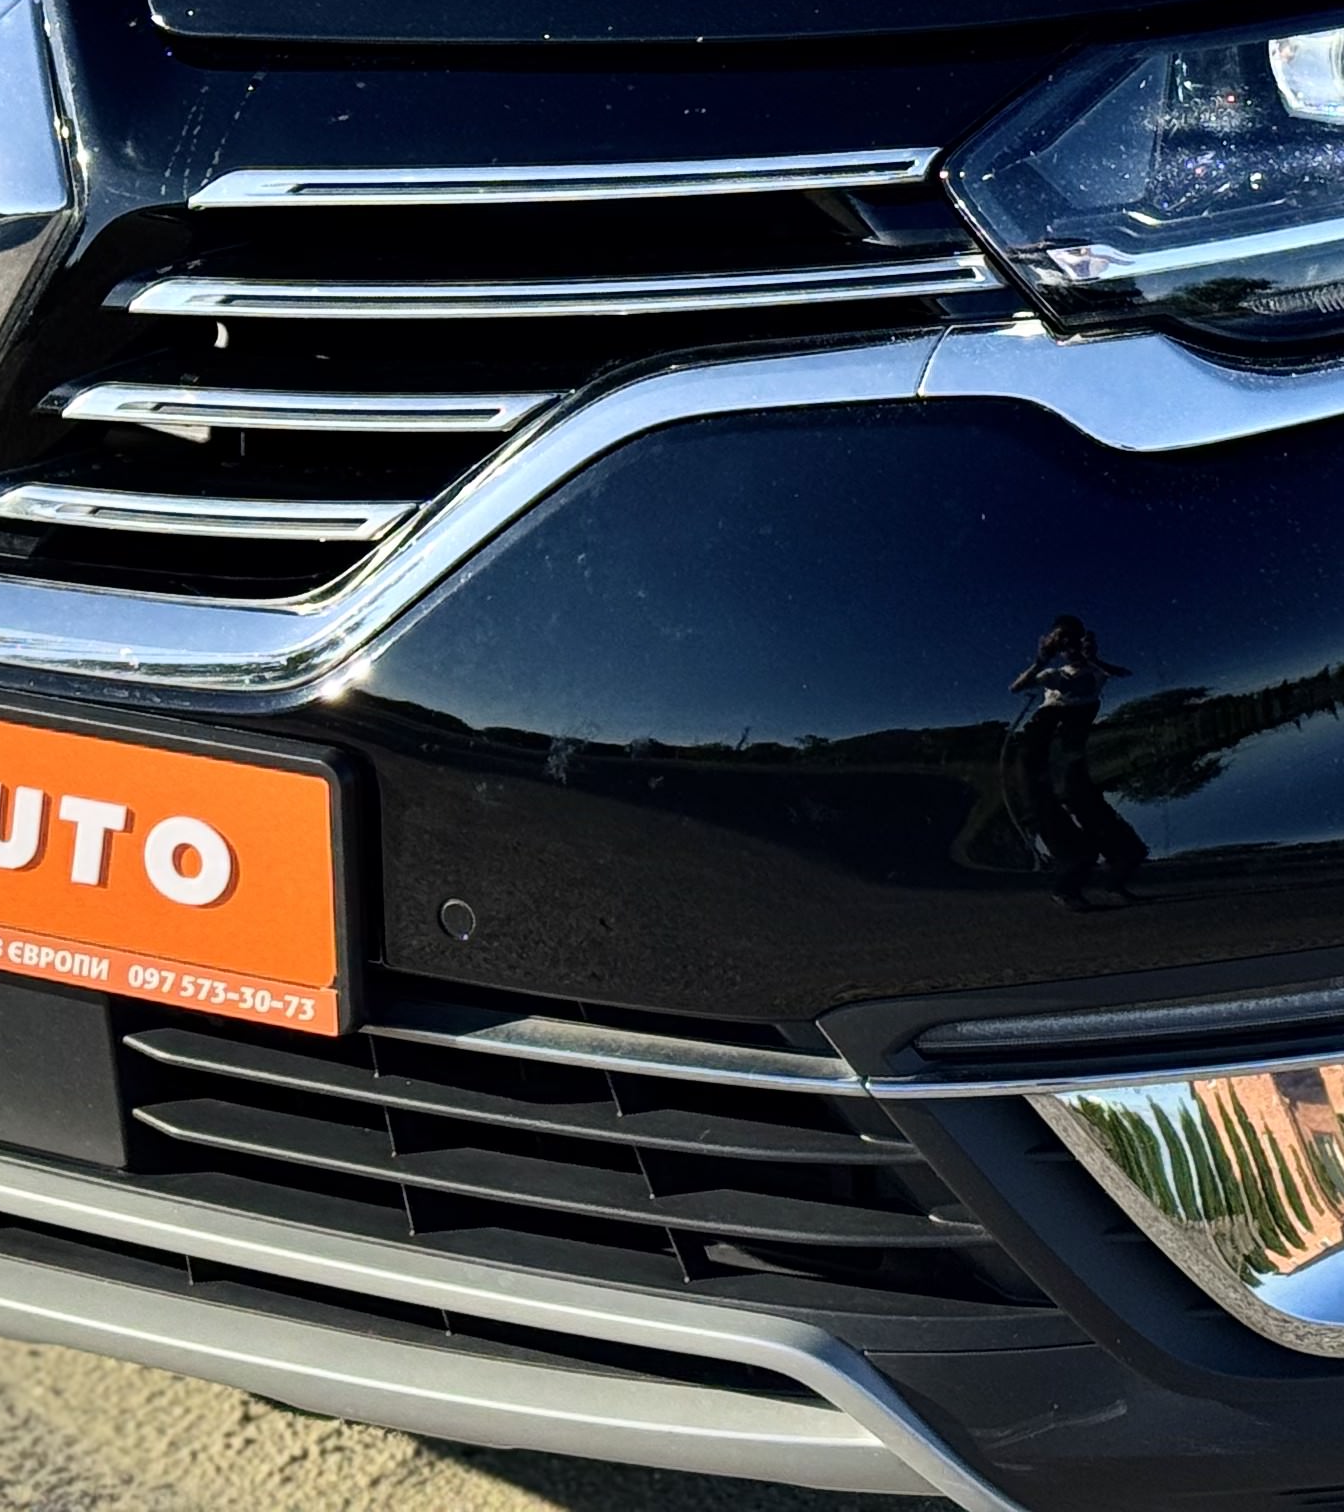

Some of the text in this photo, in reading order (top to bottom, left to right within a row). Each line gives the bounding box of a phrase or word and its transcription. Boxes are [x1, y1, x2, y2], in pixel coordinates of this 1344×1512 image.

[8, 940, 111, 981] ЄВРОПИ
[127, 963, 316, 1021] 097 573-30-73
